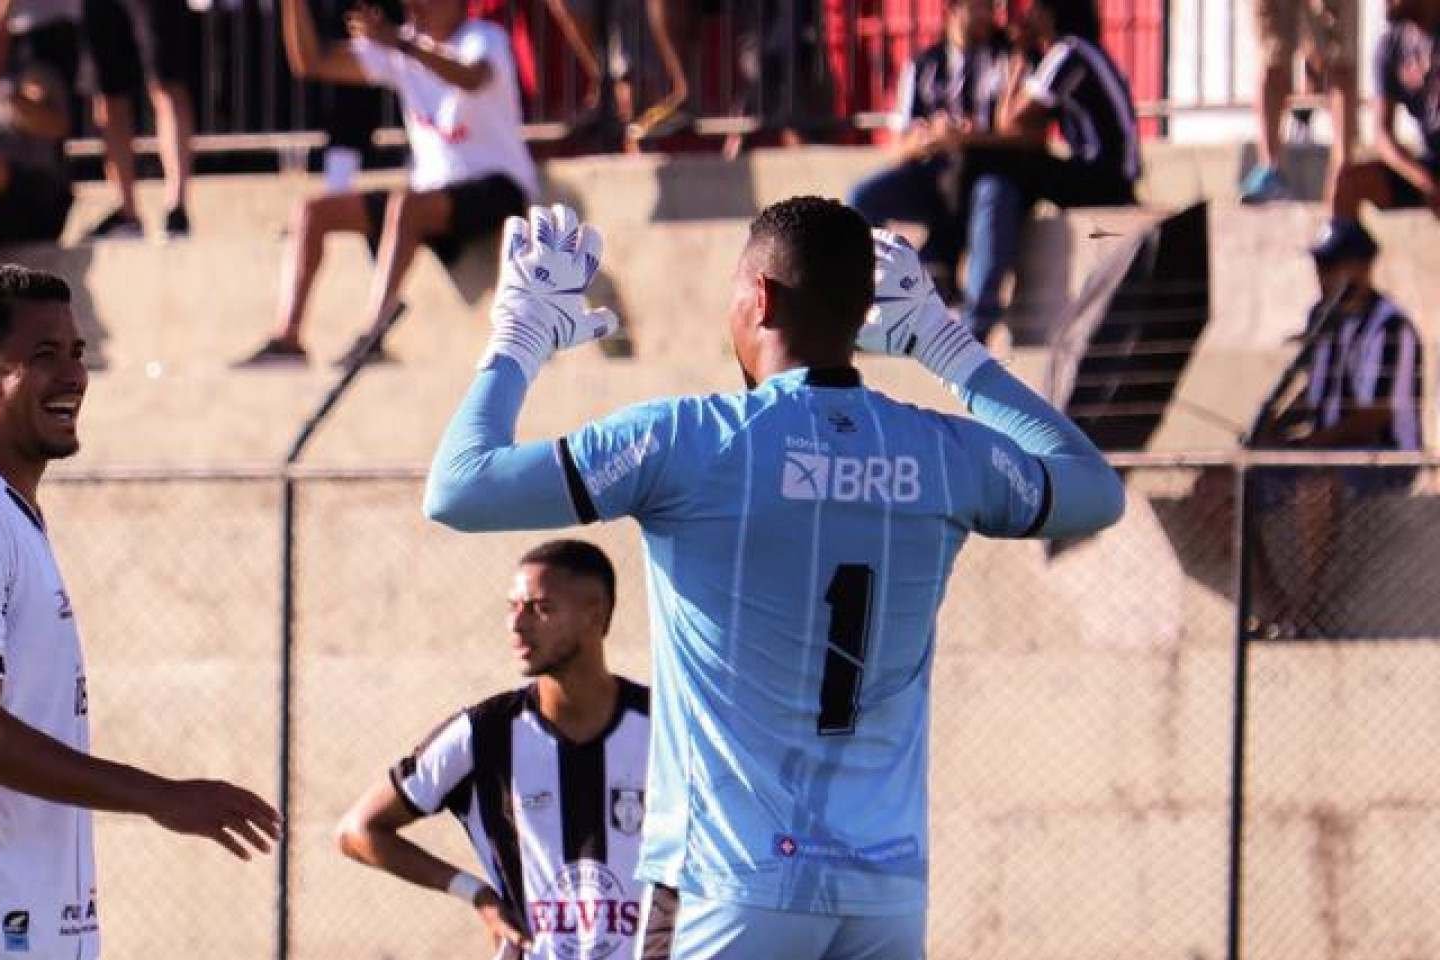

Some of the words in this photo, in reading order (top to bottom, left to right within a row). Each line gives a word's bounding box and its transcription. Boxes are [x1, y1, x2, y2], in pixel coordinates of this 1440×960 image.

[833, 456, 921, 503] BRB
[817, 564, 874, 735] 1
[528, 899, 640, 937] ELVIS
